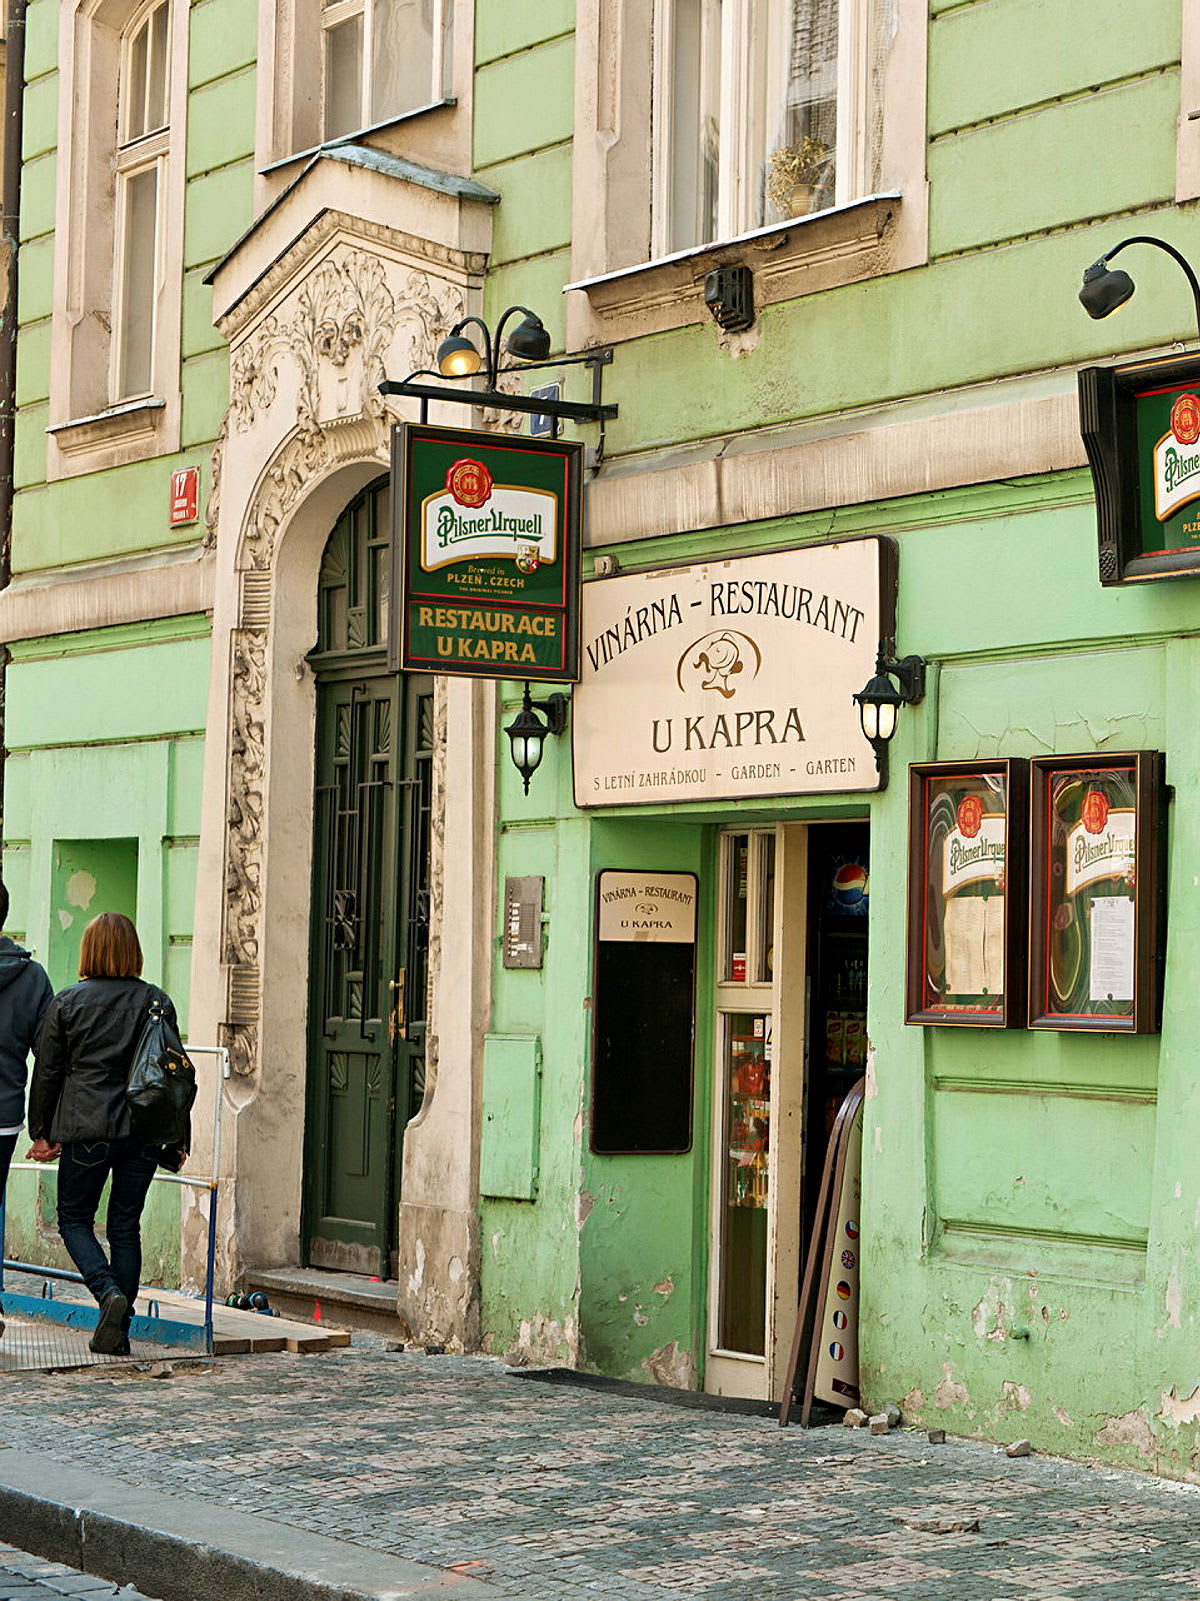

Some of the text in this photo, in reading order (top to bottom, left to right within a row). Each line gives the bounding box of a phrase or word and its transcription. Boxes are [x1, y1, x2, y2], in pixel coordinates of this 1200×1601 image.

[437, 506, 542, 548] Pilsner Urquell
[489, 576, 525, 588] CZECH
[419, 607, 556, 636] RESTAURACE
[586, 593, 684, 672] VINÁRNA
[710, 581, 865, 644] RESTAURANT
[437, 636, 537, 663] U KAPRA
[652, 707, 806, 753] U KAPRA
[593, 777, 601, 790] S
[604, 771, 636, 790] LETNÍ
[638, 766, 707, 788] ZAHRÁDKOU
[731, 763, 781, 780] GARDEN
[806, 757, 856, 775] GARTEN
[950, 838, 981, 875] Pilsner
[1074, 835, 1108, 874] Pilsner
[644, 886, 693, 905] RESTAURANT
[620, 920, 673, 929] U KAPRA
